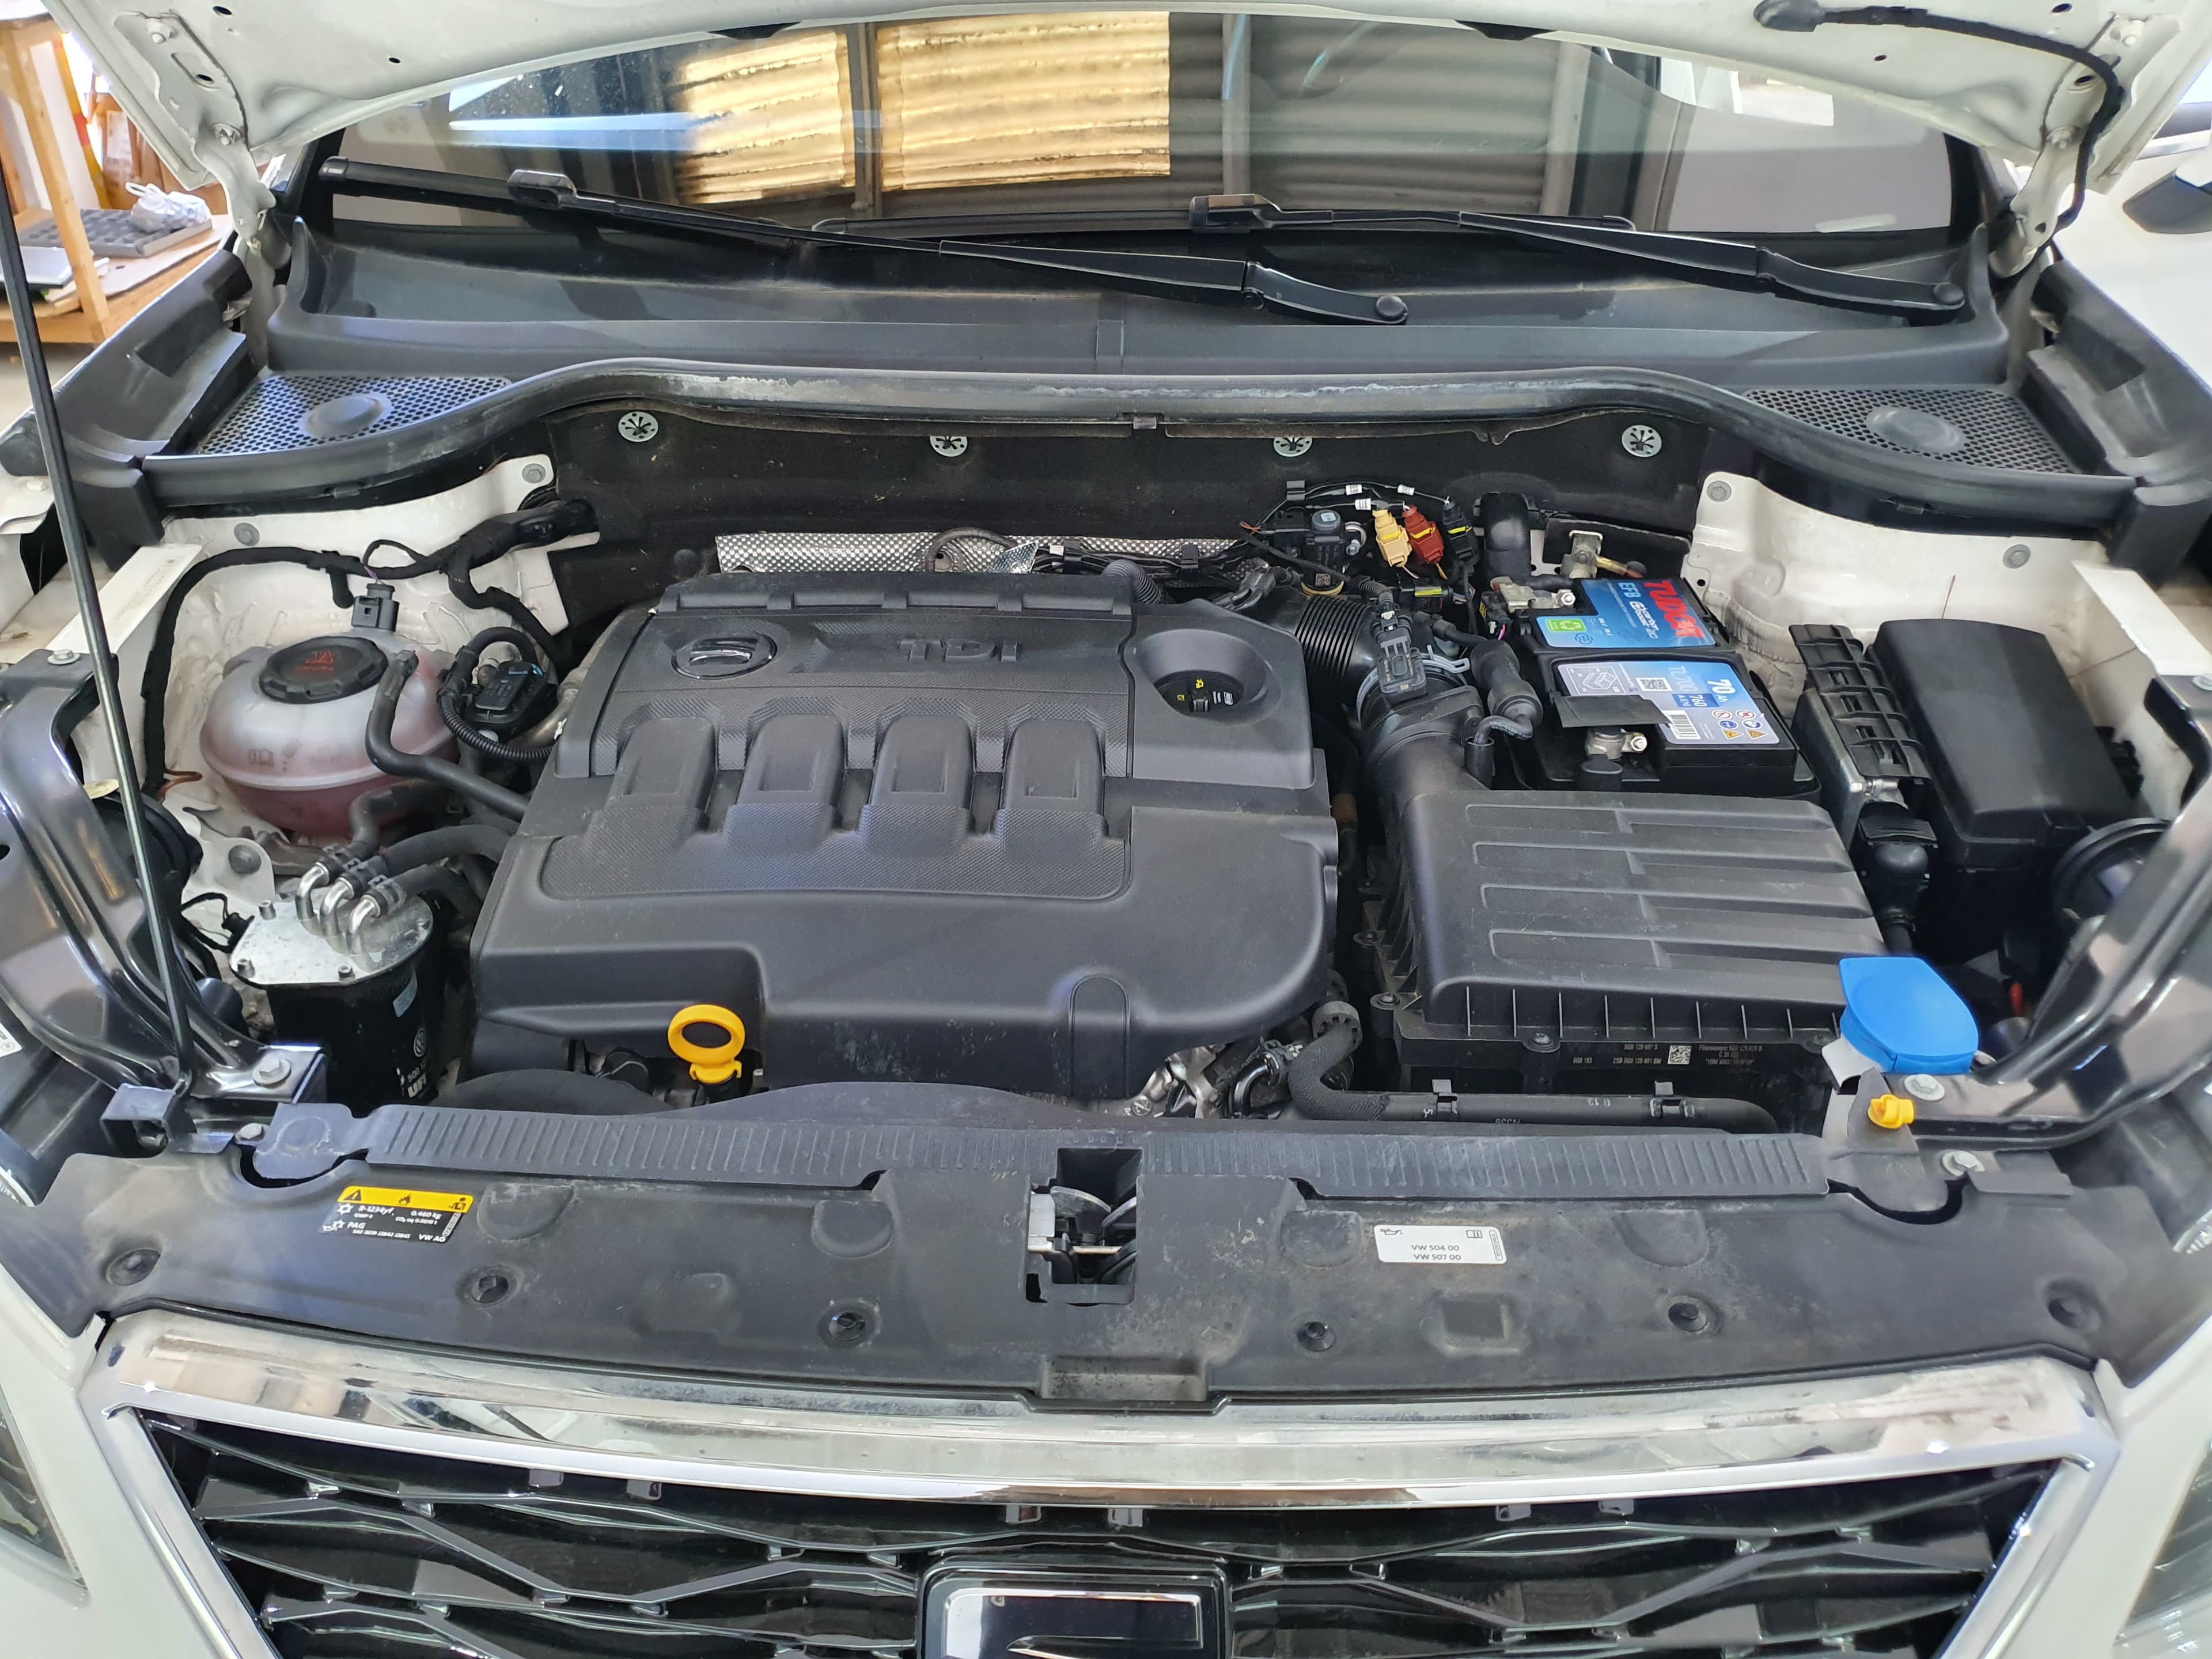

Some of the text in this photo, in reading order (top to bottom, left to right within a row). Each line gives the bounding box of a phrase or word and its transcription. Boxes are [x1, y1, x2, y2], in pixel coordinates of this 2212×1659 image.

[1618, 582, 1642, 598] EFB
[1643, 580, 1705, 638] TUDOR
[897, 638, 1022, 663] TDI
[1706, 679, 1737, 694] 70
[1690, 694, 1708, 707] 760
[432, 1212, 442, 1220] kg
[347, 1221, 366, 1229] PAG
